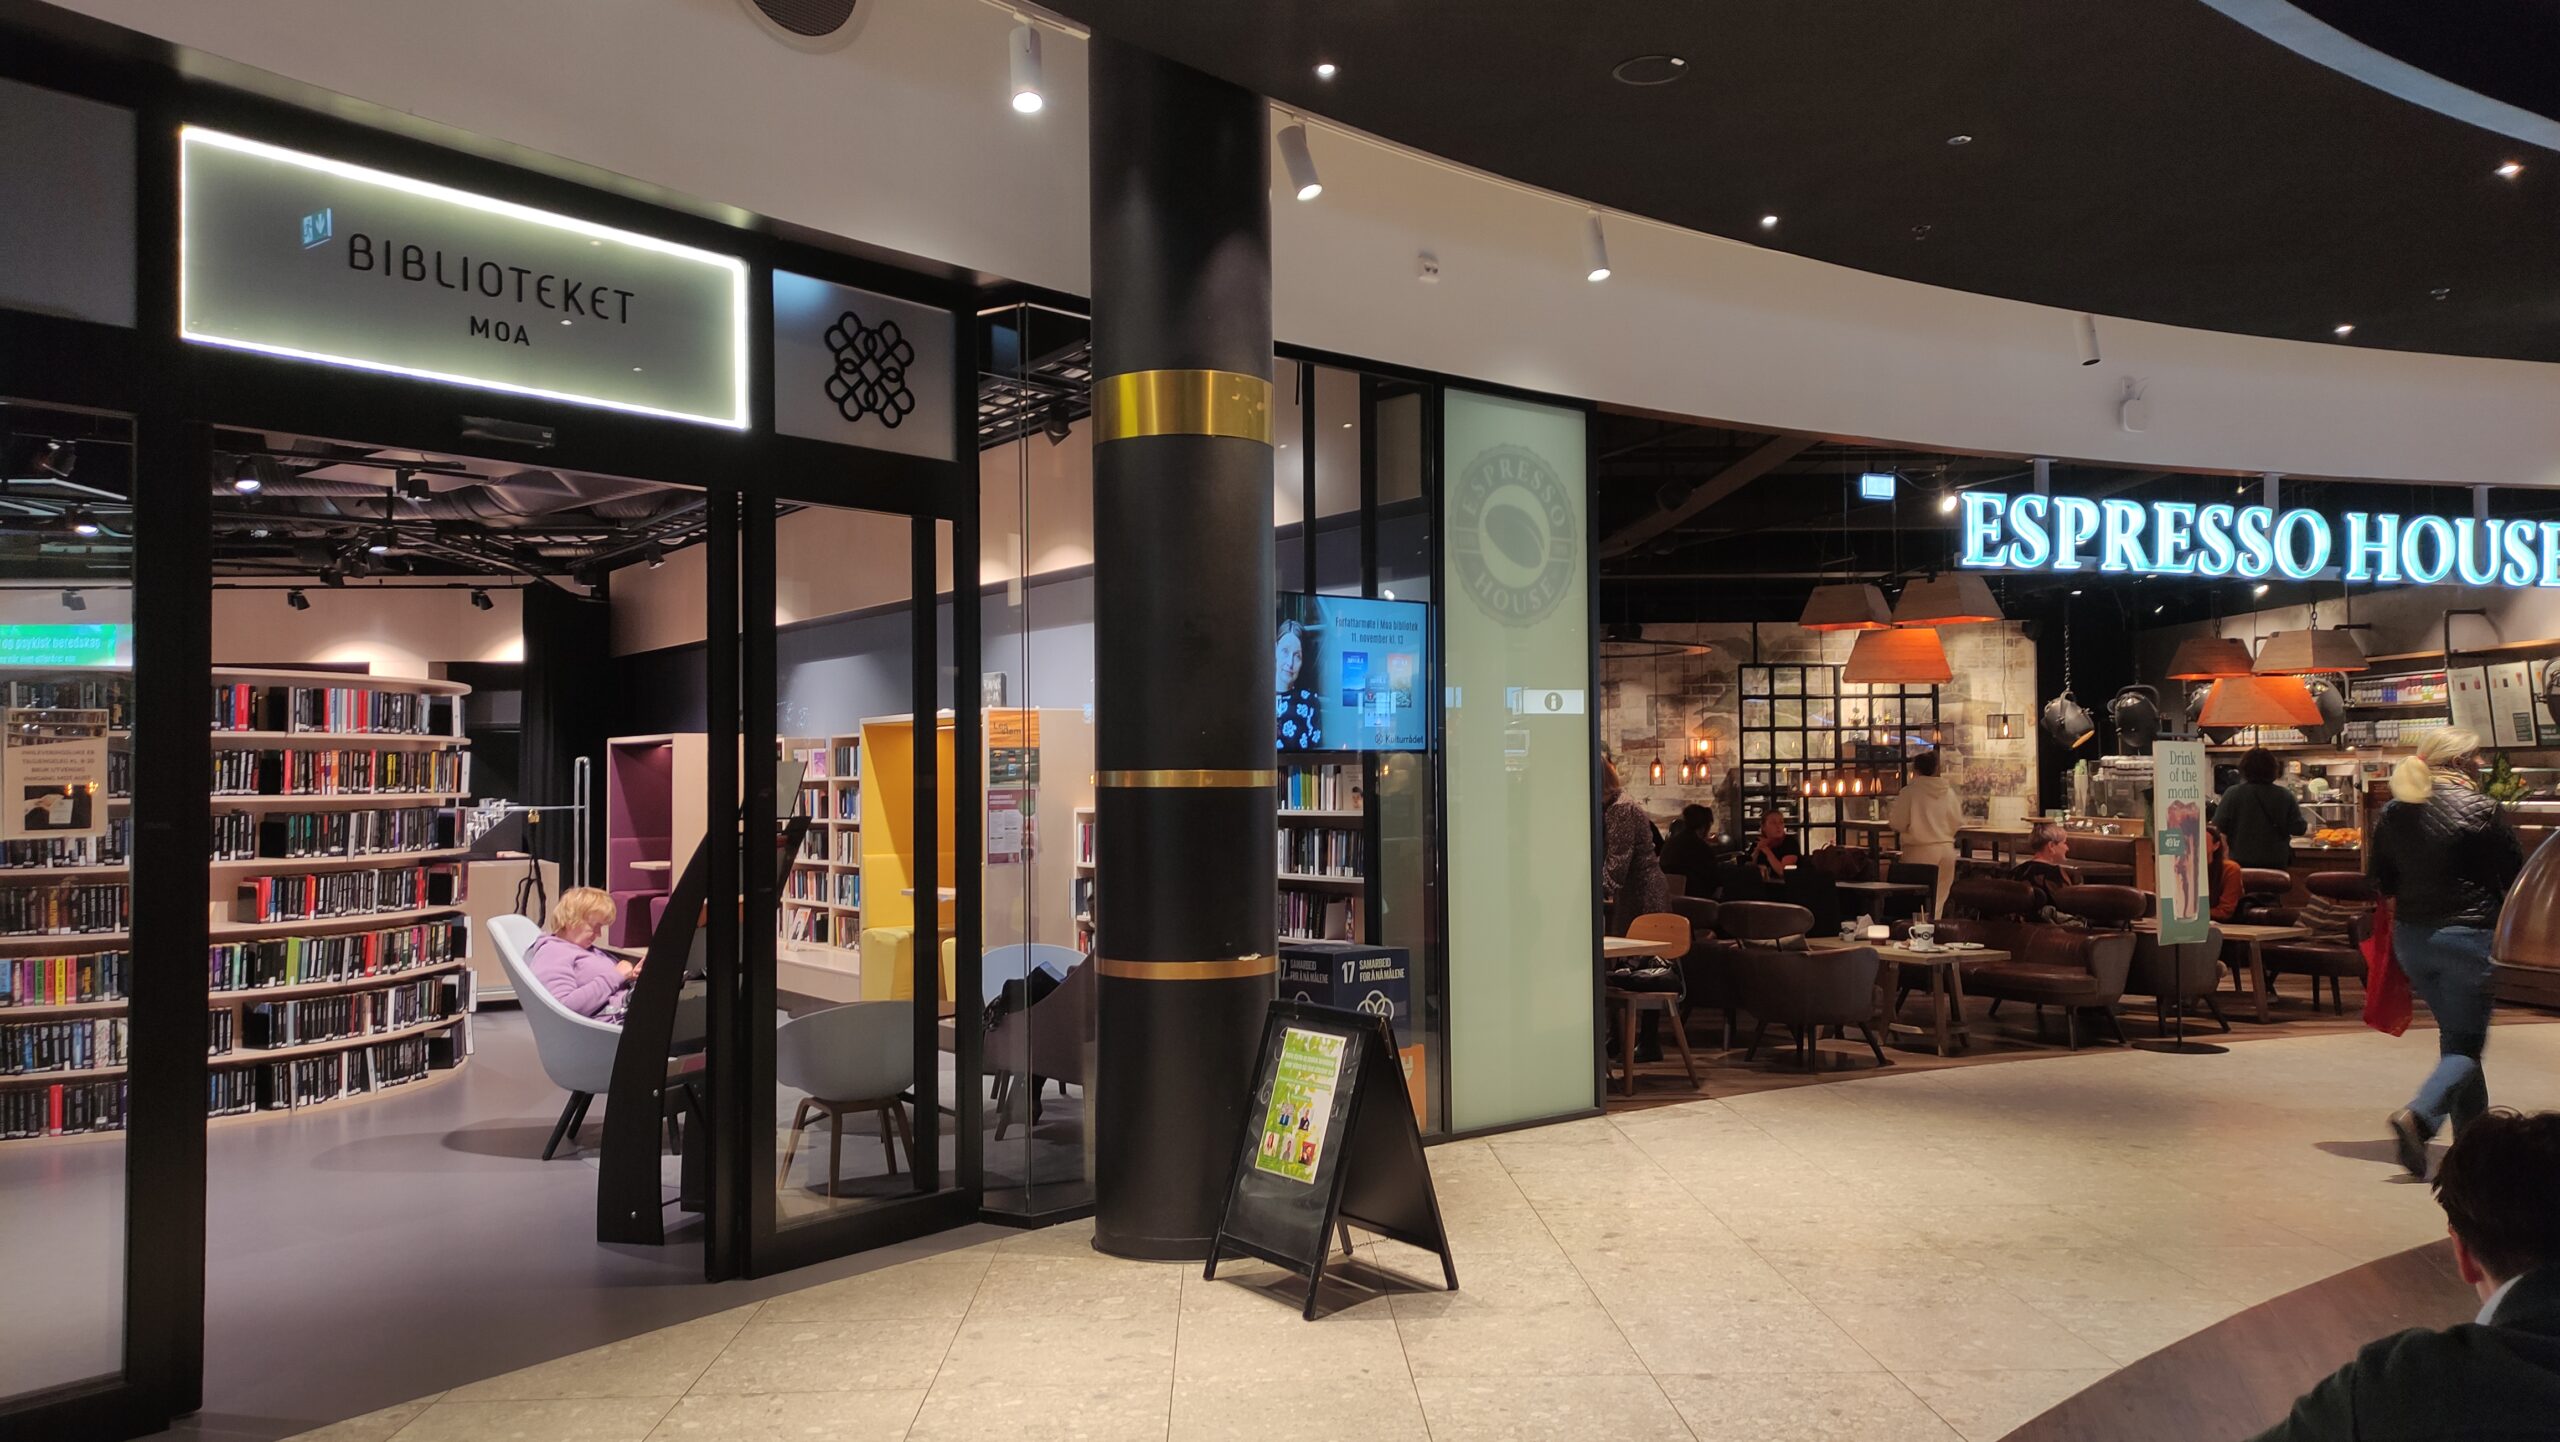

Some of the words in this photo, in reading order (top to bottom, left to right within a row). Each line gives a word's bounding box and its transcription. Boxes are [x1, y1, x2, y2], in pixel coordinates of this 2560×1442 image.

[349, 233, 635, 324] BIBLIOTEKET
[470, 315, 530, 346] MOA
[1463, 458, 1566, 527] ESPRESSO
[1961, 492, 2331, 579] ESPRESSO
[1474, 571, 1553, 615] HOUSE
[1385, 734, 1424, 745] Kulturrådet
[2169, 751, 2196, 766] Drink
[2169, 768, 2179, 782] of
[2182, 768, 2198, 782] the
[2168, 785, 2199, 799] month
[1341, 961, 1355, 983] 17
[1359, 957, 1391, 970] SAMARBEID
[1360, 971, 1371, 983] FOR
[1384, 968, 1405, 979] MÅLENE
